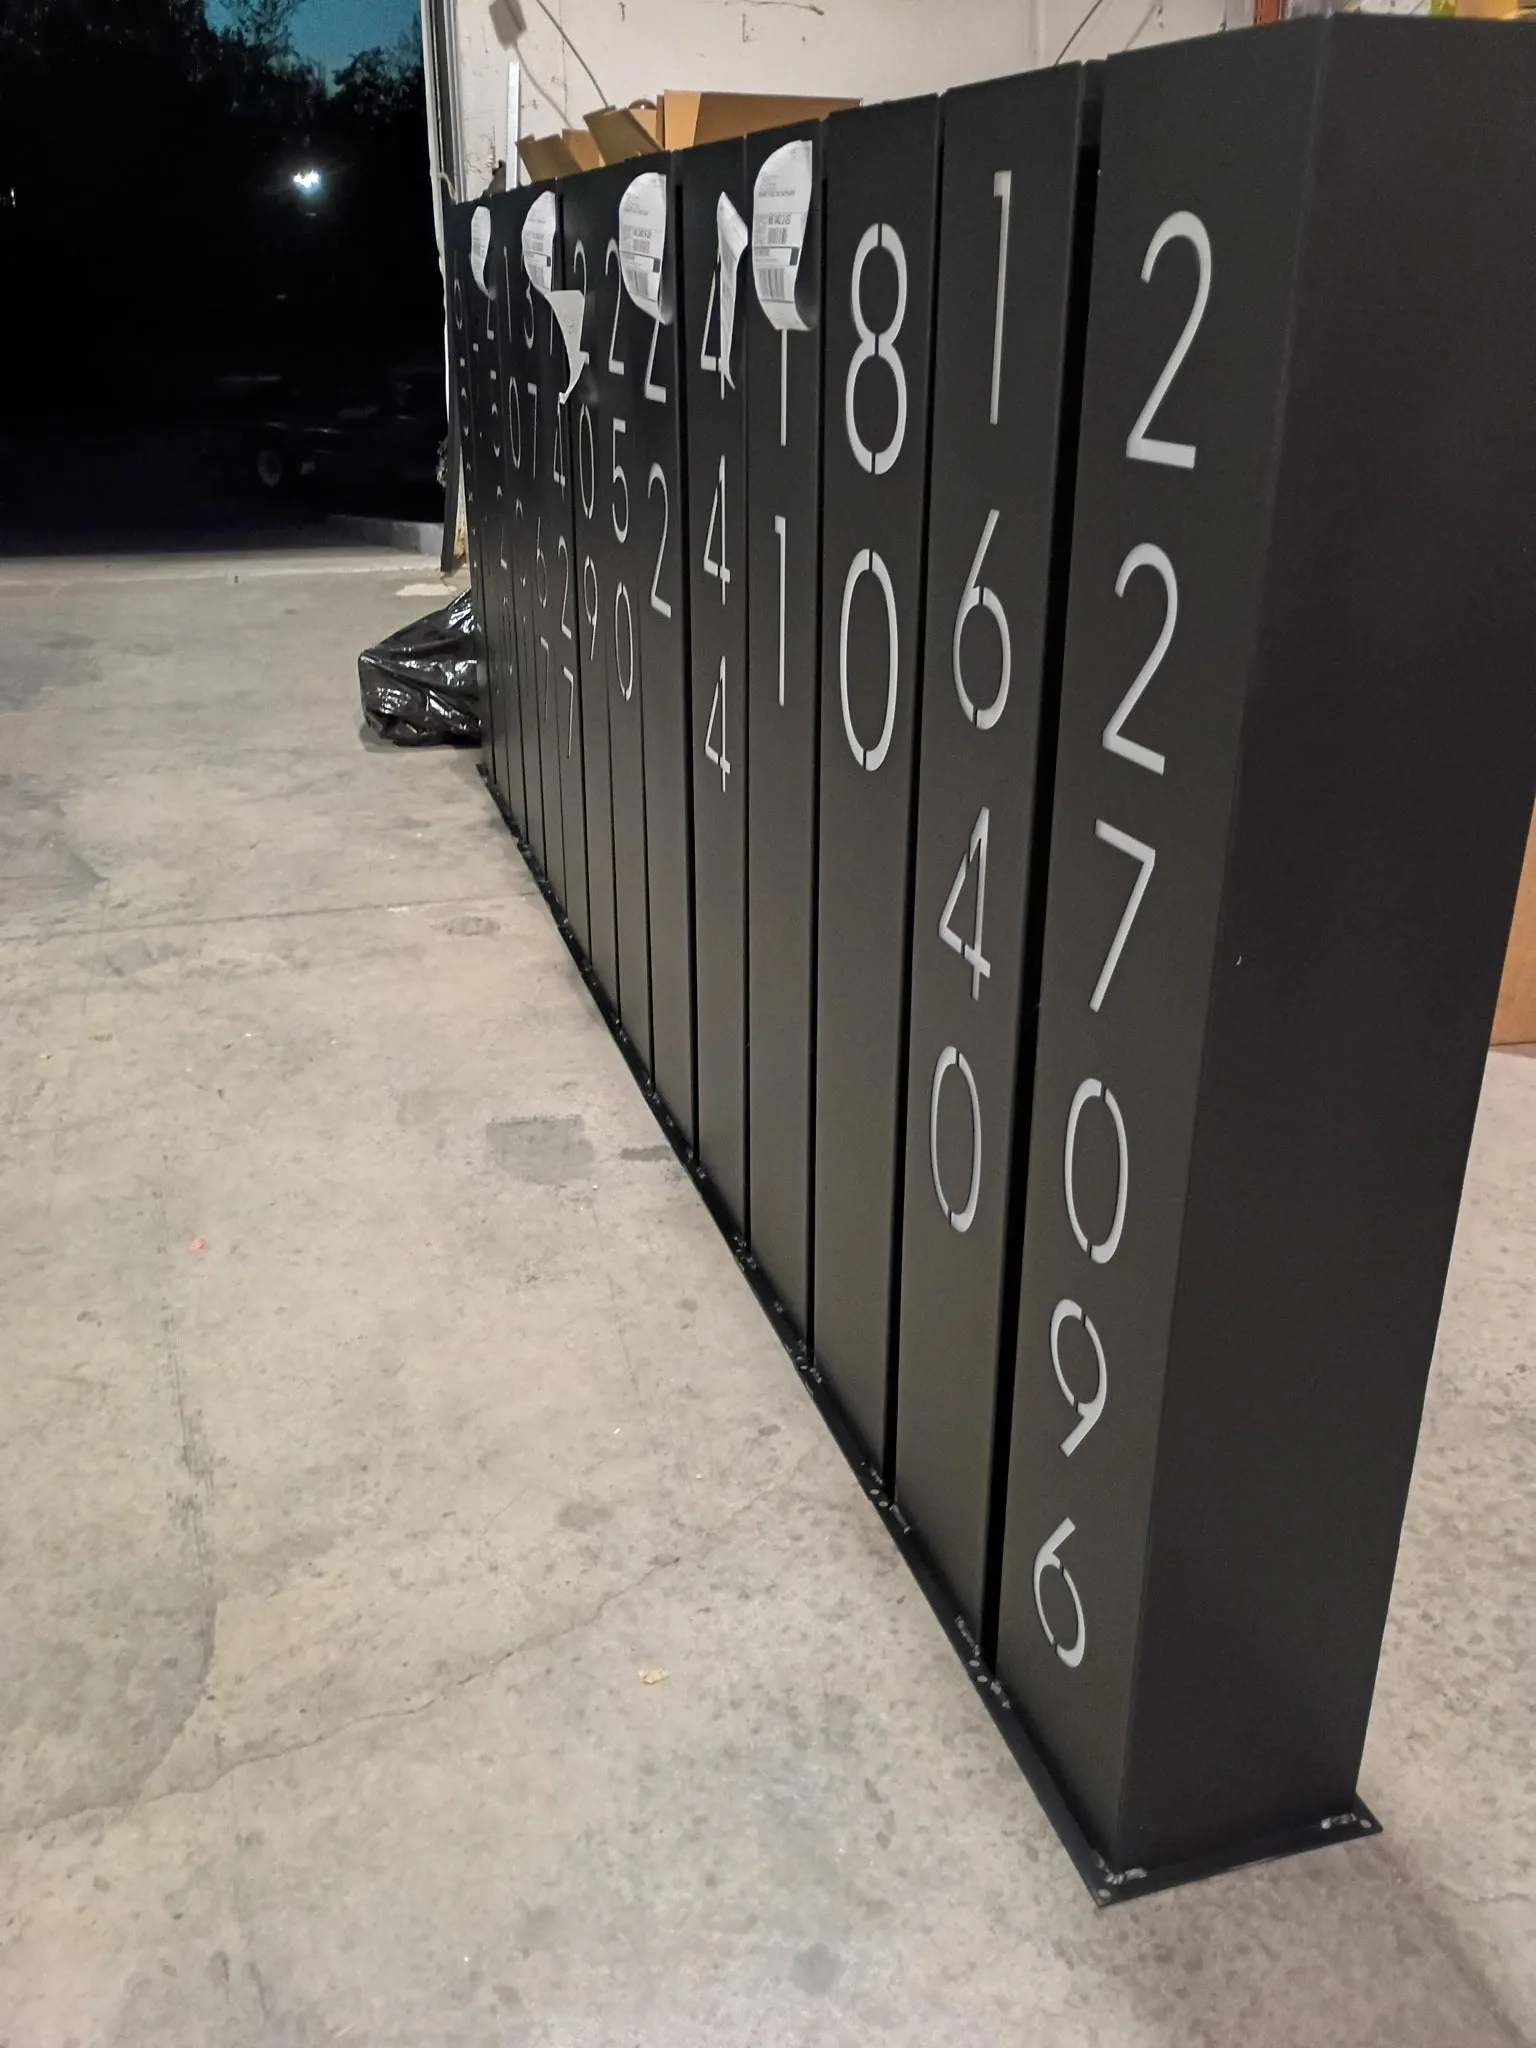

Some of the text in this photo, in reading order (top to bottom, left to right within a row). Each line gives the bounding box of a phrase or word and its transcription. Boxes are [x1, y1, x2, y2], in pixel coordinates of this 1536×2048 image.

[573, 240, 599, 661] 209
[604, 237, 635, 703] 250
[839, 222, 909, 773] 80
[930, 170, 1013, 1234] 1640
[1033, 210, 1214, 1669] 227096
